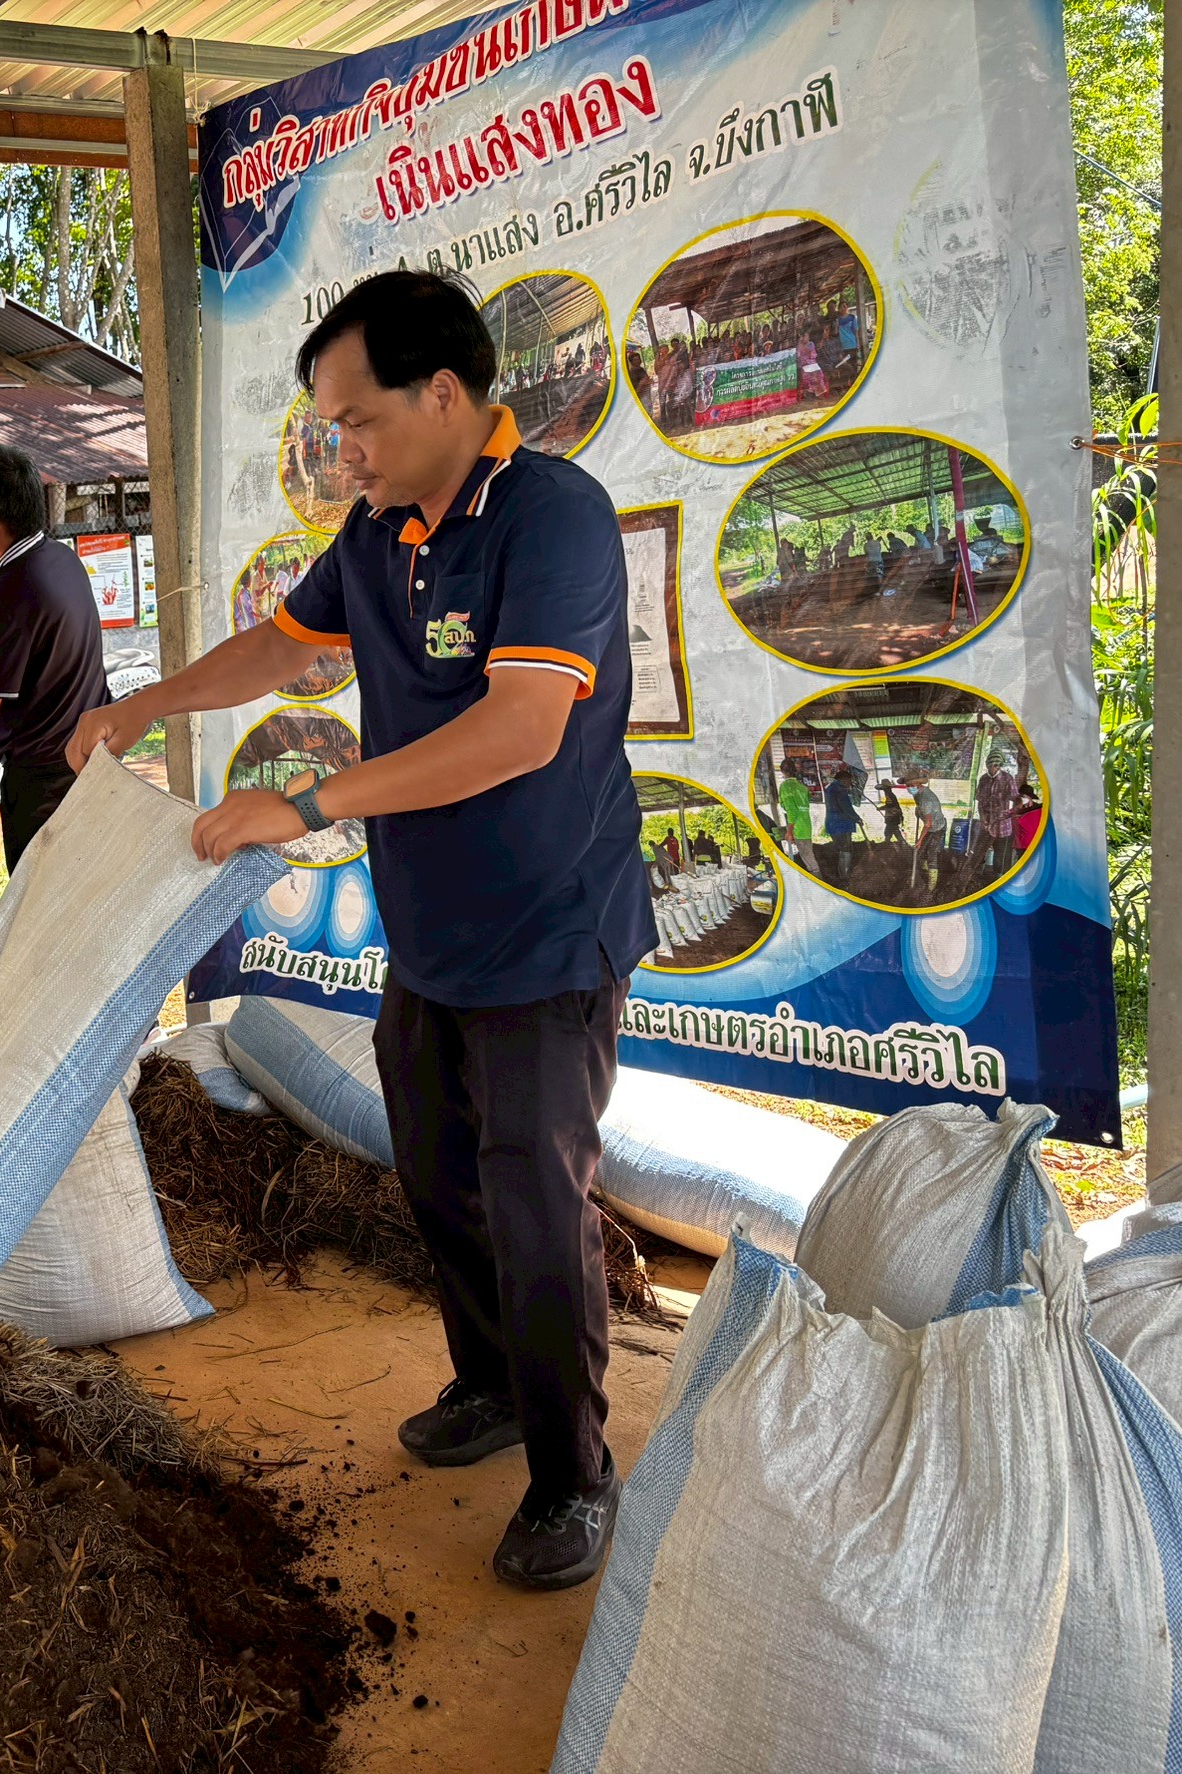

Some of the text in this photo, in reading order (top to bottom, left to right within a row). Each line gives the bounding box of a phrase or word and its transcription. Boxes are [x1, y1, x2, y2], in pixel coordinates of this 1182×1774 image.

[375, 60, 657, 222] เนินแสงทอง
[553, 150, 671, 238] อ.ศรีวิไล
[689, 72, 839, 180] จ.บึงกาฬ
